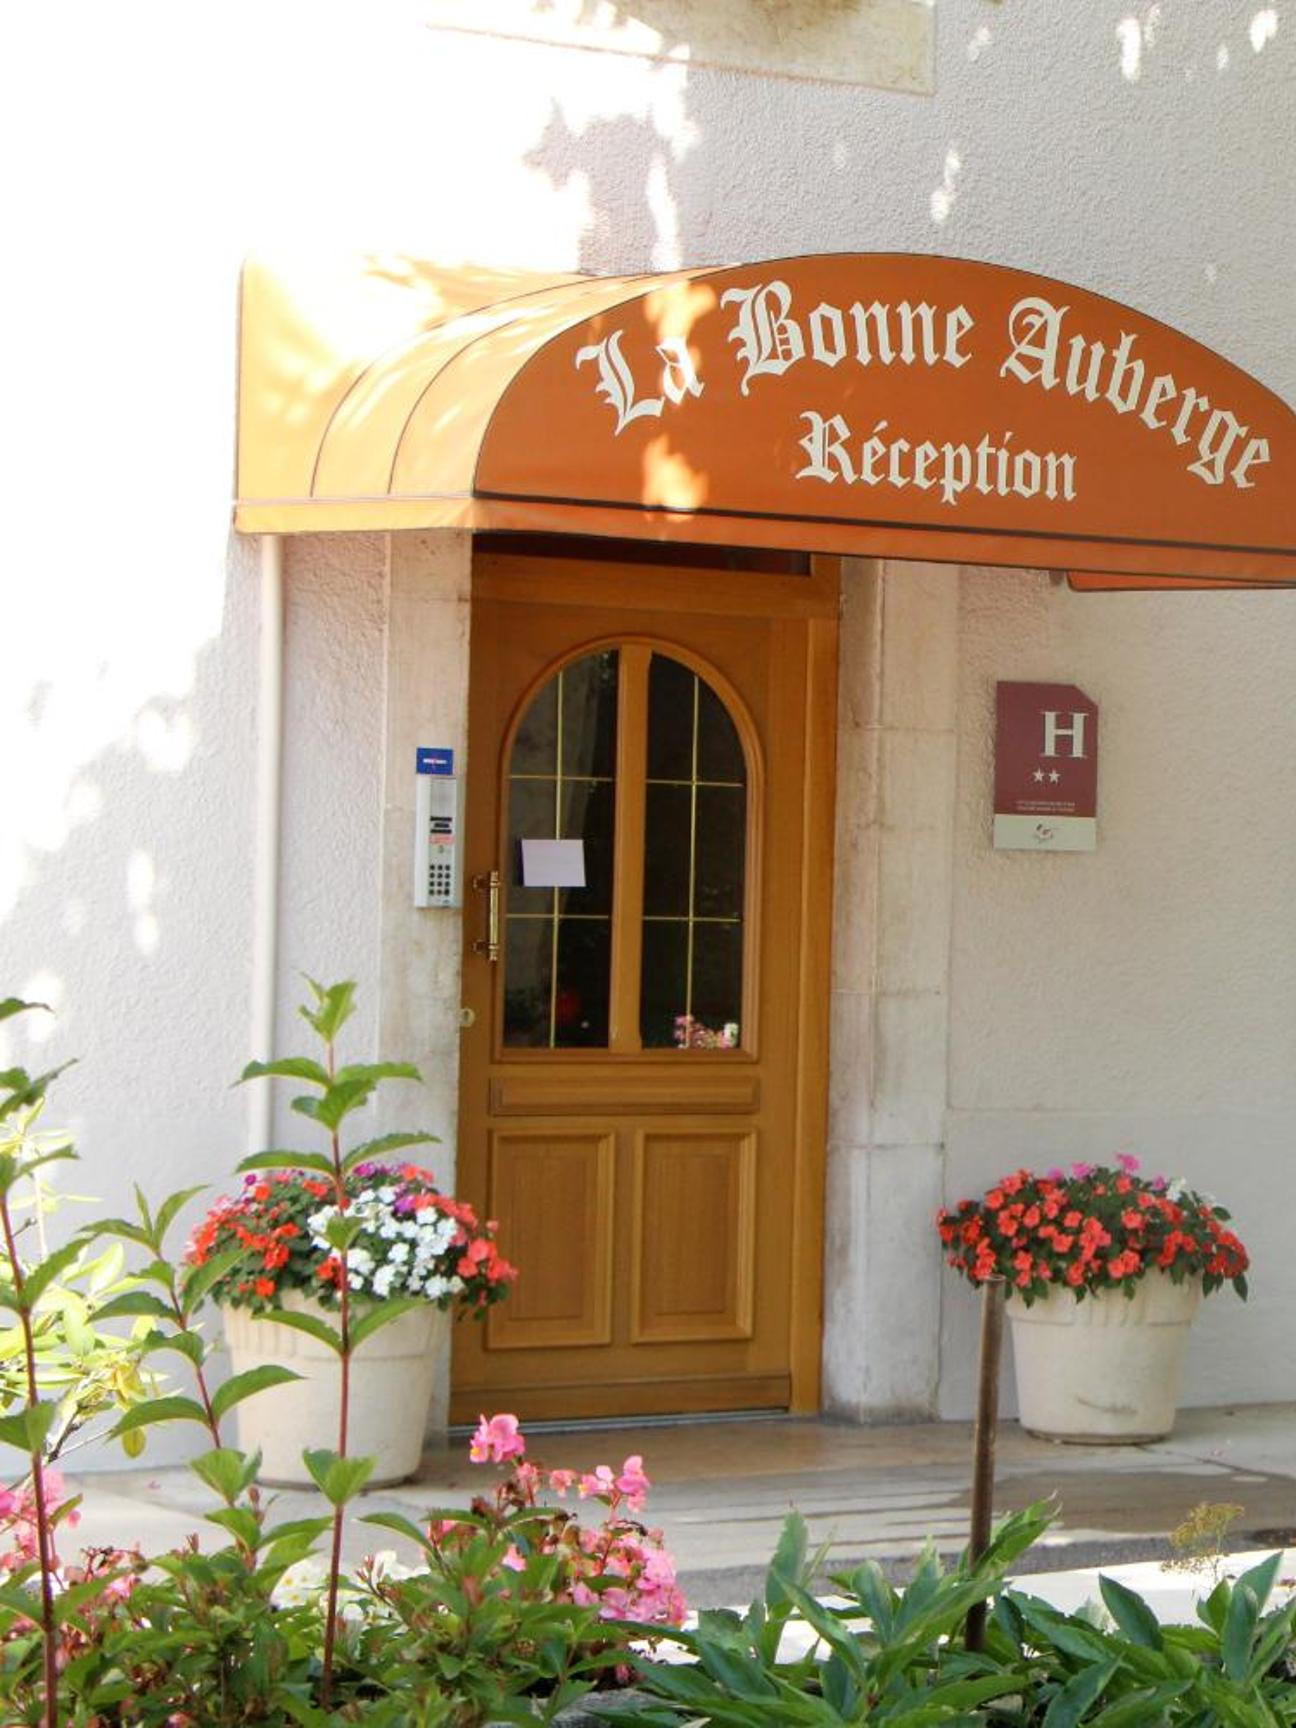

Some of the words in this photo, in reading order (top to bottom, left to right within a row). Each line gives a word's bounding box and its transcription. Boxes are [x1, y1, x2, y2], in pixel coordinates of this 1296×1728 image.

[575, 330, 705, 436] La
[720, 280, 974, 396] Bonne
[1000, 297, 1270, 488] Auberge
[796, 411, 1077, 504] Réception
[1040, 711, 1089, 758] H
